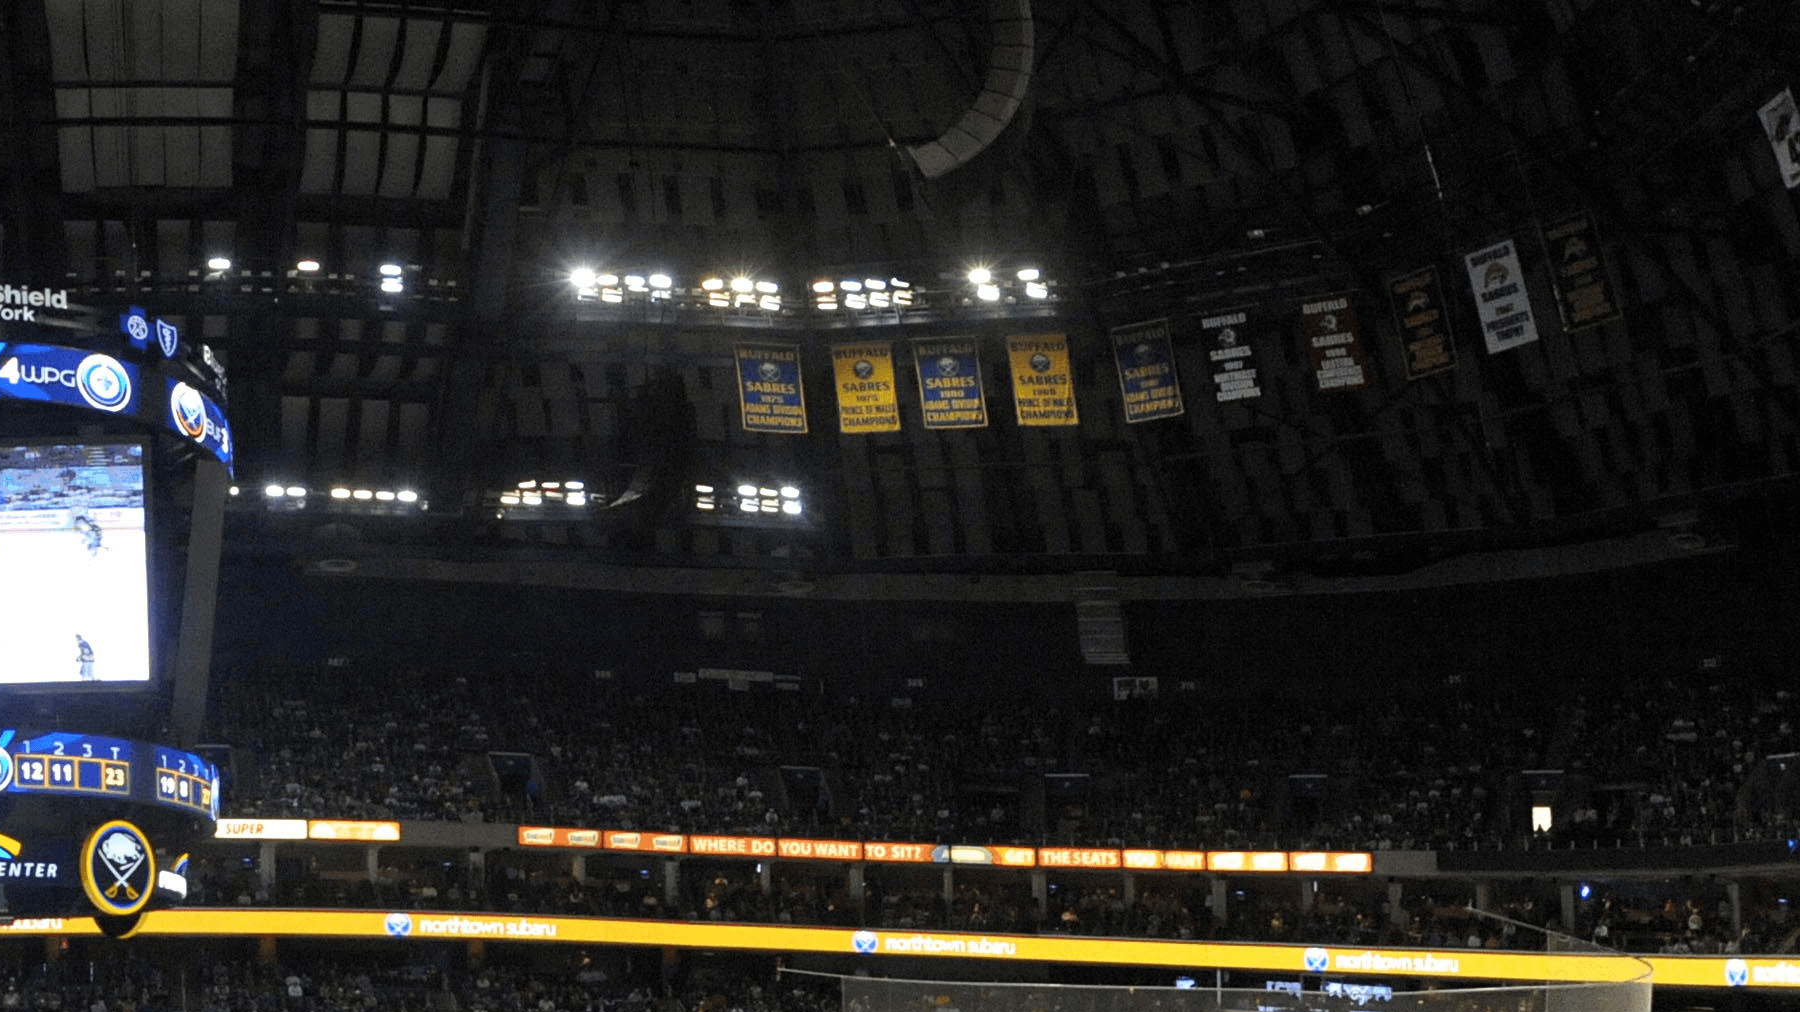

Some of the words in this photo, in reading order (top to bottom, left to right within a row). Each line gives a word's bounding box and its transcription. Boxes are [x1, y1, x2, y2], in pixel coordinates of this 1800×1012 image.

[20, 365, 75, 387] WPG
[926, 376, 975, 388] SABRES
[746, 381, 795, 394] SABRES
[842, 381, 890, 392] SABRES
[23, 740, 30, 753] 1
[54, 742, 64, 756] 2
[82, 744, 93, 758] 3
[110, 747, 120, 760] T
[21, 762, 44, 780] 12
[52, 764, 72, 782] 11
[106, 767, 125, 786] 23
[179, 760, 186, 773] 2
[160, 776, 175, 794] 19
[226, 823, 264, 835] SUPER
[693, 836, 746, 852] WHERE
[751, 839, 775, 854] DO
[780, 841, 811, 855] YOU
[813, 842, 859, 857] WANT
[865, 845, 886, 857] TO
[891, 846, 921, 859] SIT?
[1042, 851, 1070, 864] THE
[1073, 851, 1117, 865] SEATS
[419, 917, 504, 934] northtown
[505, 918, 557, 936] subaru
[885, 935, 965, 952] northtown
[968, 937, 1015, 955] subaru
